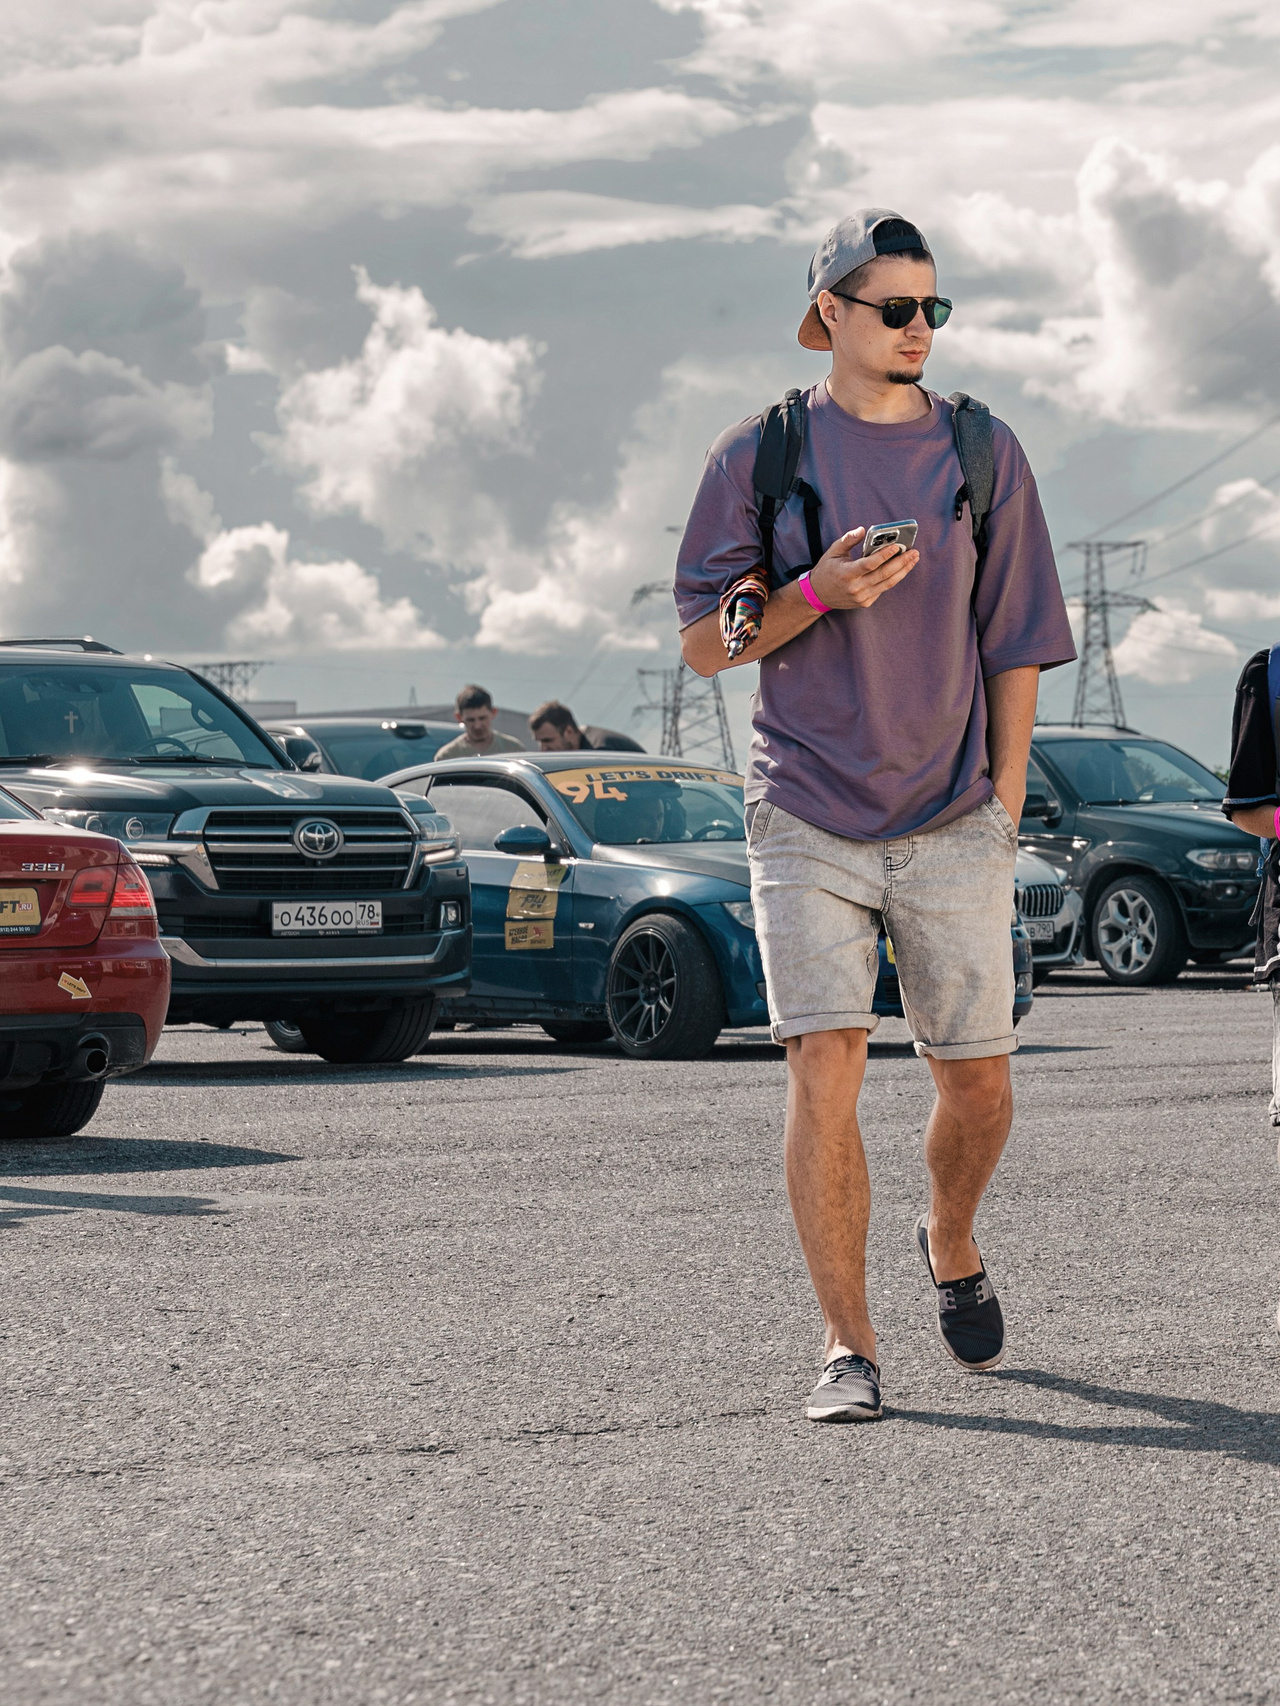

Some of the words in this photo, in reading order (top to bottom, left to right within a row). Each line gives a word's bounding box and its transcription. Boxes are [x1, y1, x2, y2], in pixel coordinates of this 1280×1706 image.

[586, 771, 651, 782] LET'S
[556, 781, 628, 804] 94
[359, 904, 375, 919] 78
